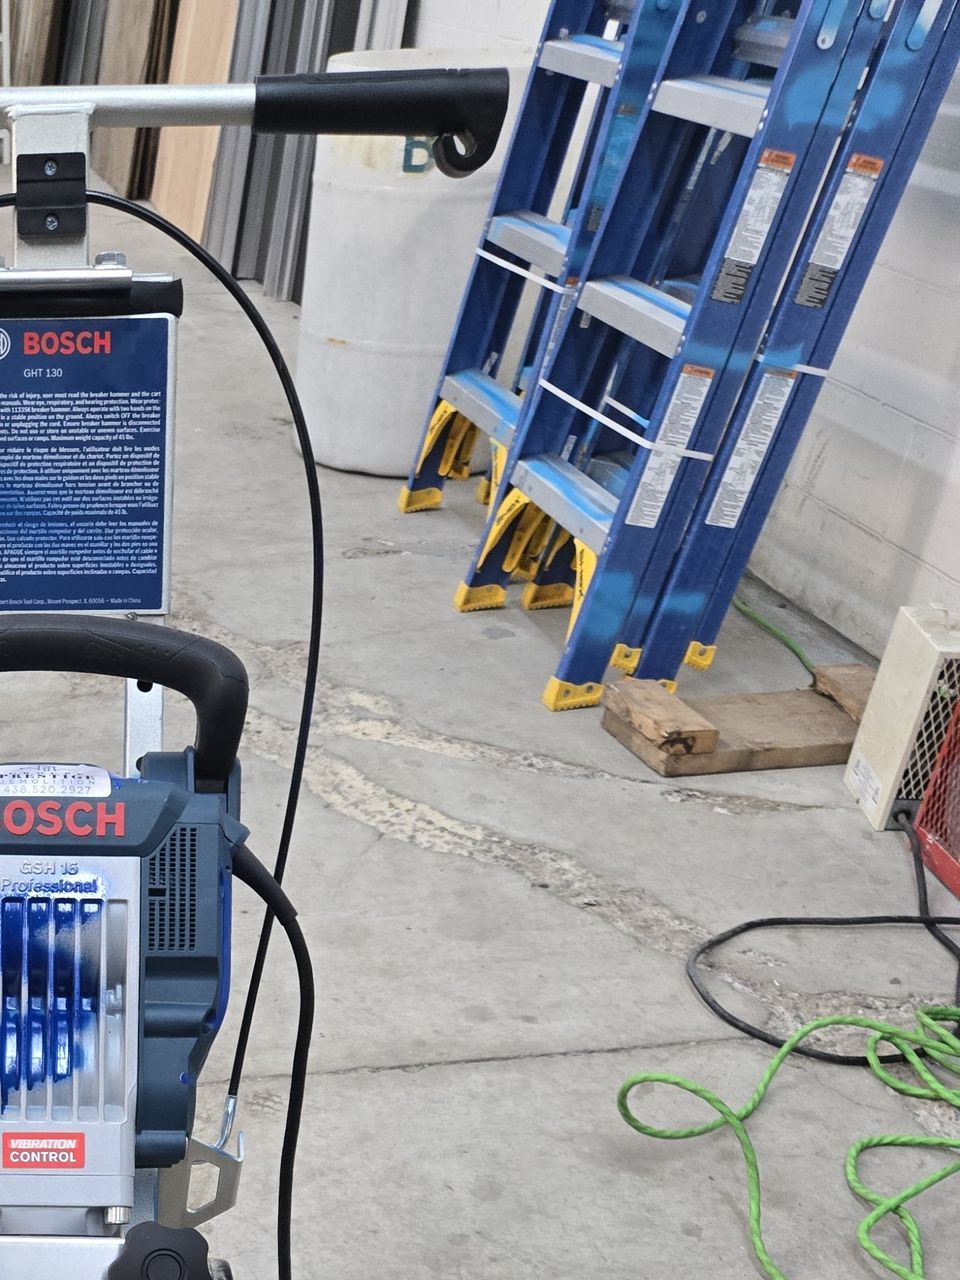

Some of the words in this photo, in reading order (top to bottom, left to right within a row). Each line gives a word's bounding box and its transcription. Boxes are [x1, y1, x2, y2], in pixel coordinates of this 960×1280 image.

[23, 331, 111, 355] BOSCH
[23, 368, 43, 378] GHT
[46, 368, 63, 378] 130
[3, 785, 91, 794] 438.520.2927
[20, 861, 56, 875] GSH
[61, 861, 79, 875] 16
[1, 878, 99, 893] Professional
[10, 1138, 77, 1149] VIBRATION
[9, 1151, 77, 1162] CONTROL
